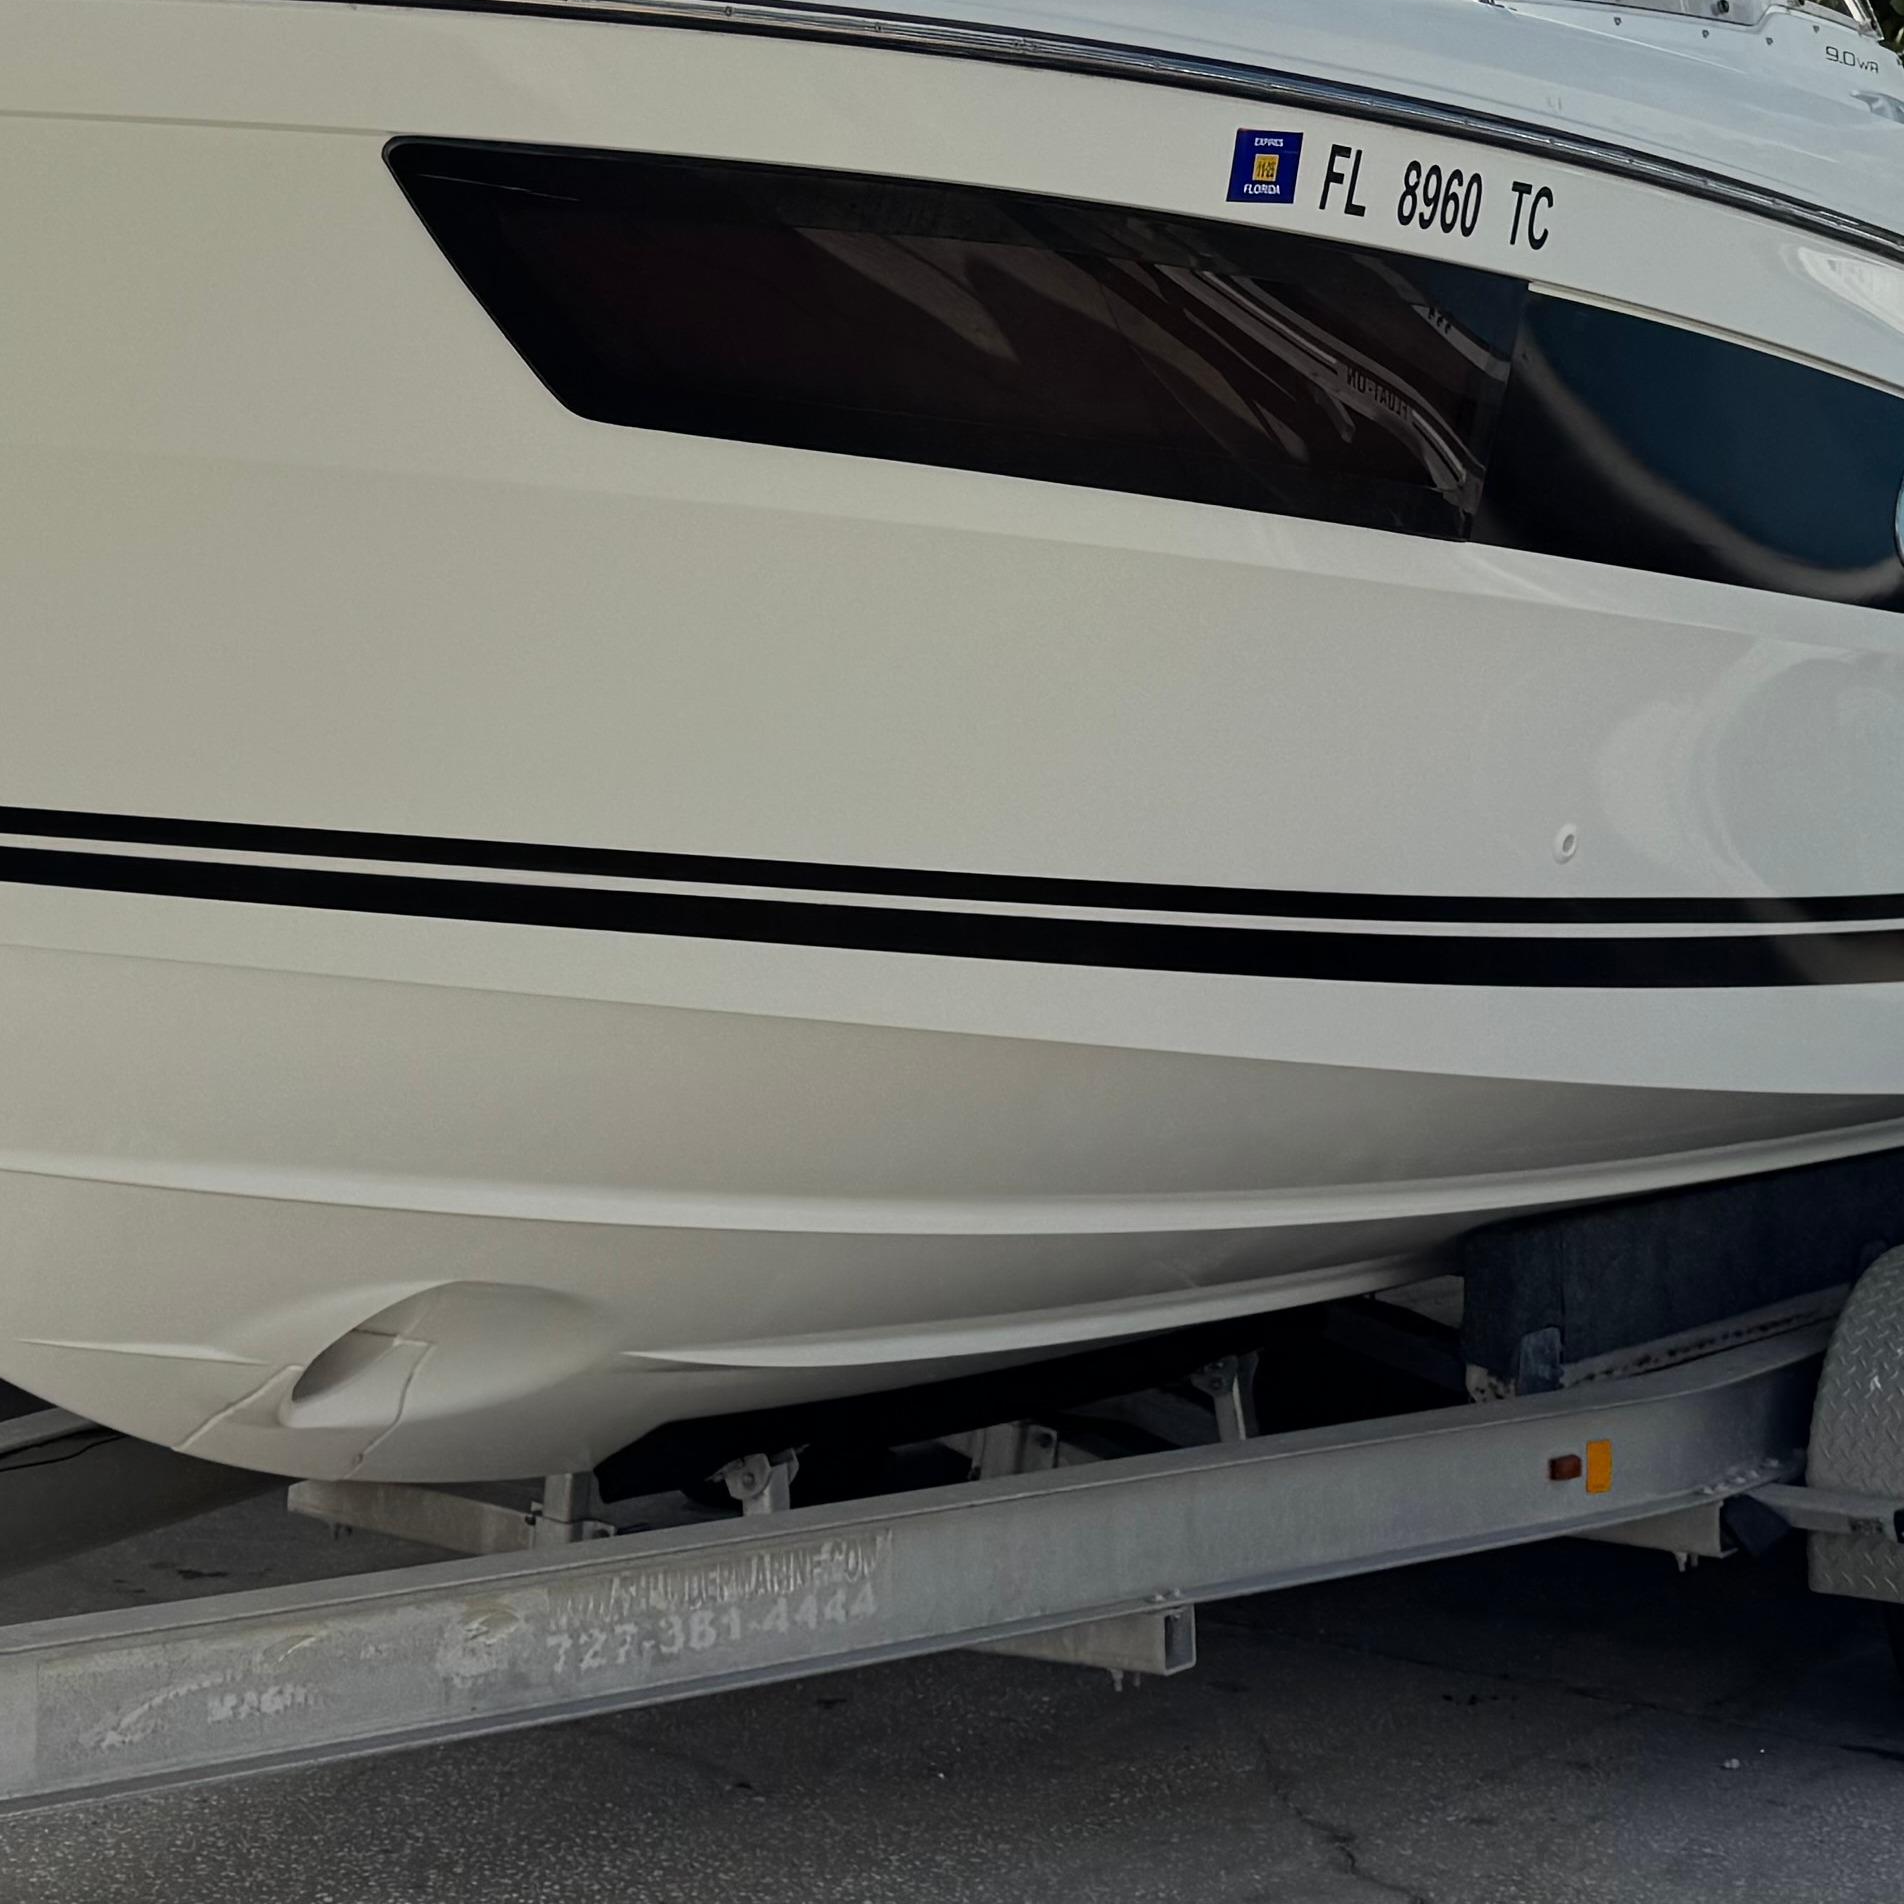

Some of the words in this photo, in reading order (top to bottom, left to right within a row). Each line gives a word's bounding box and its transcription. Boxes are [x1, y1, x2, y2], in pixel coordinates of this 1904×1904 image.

[1243, 183, 1281, 195] FLORIDA
[1318, 143, 1366, 217] FL
[1397, 160, 1483, 237] 8960
[1509, 181, 1554, 250] TC
